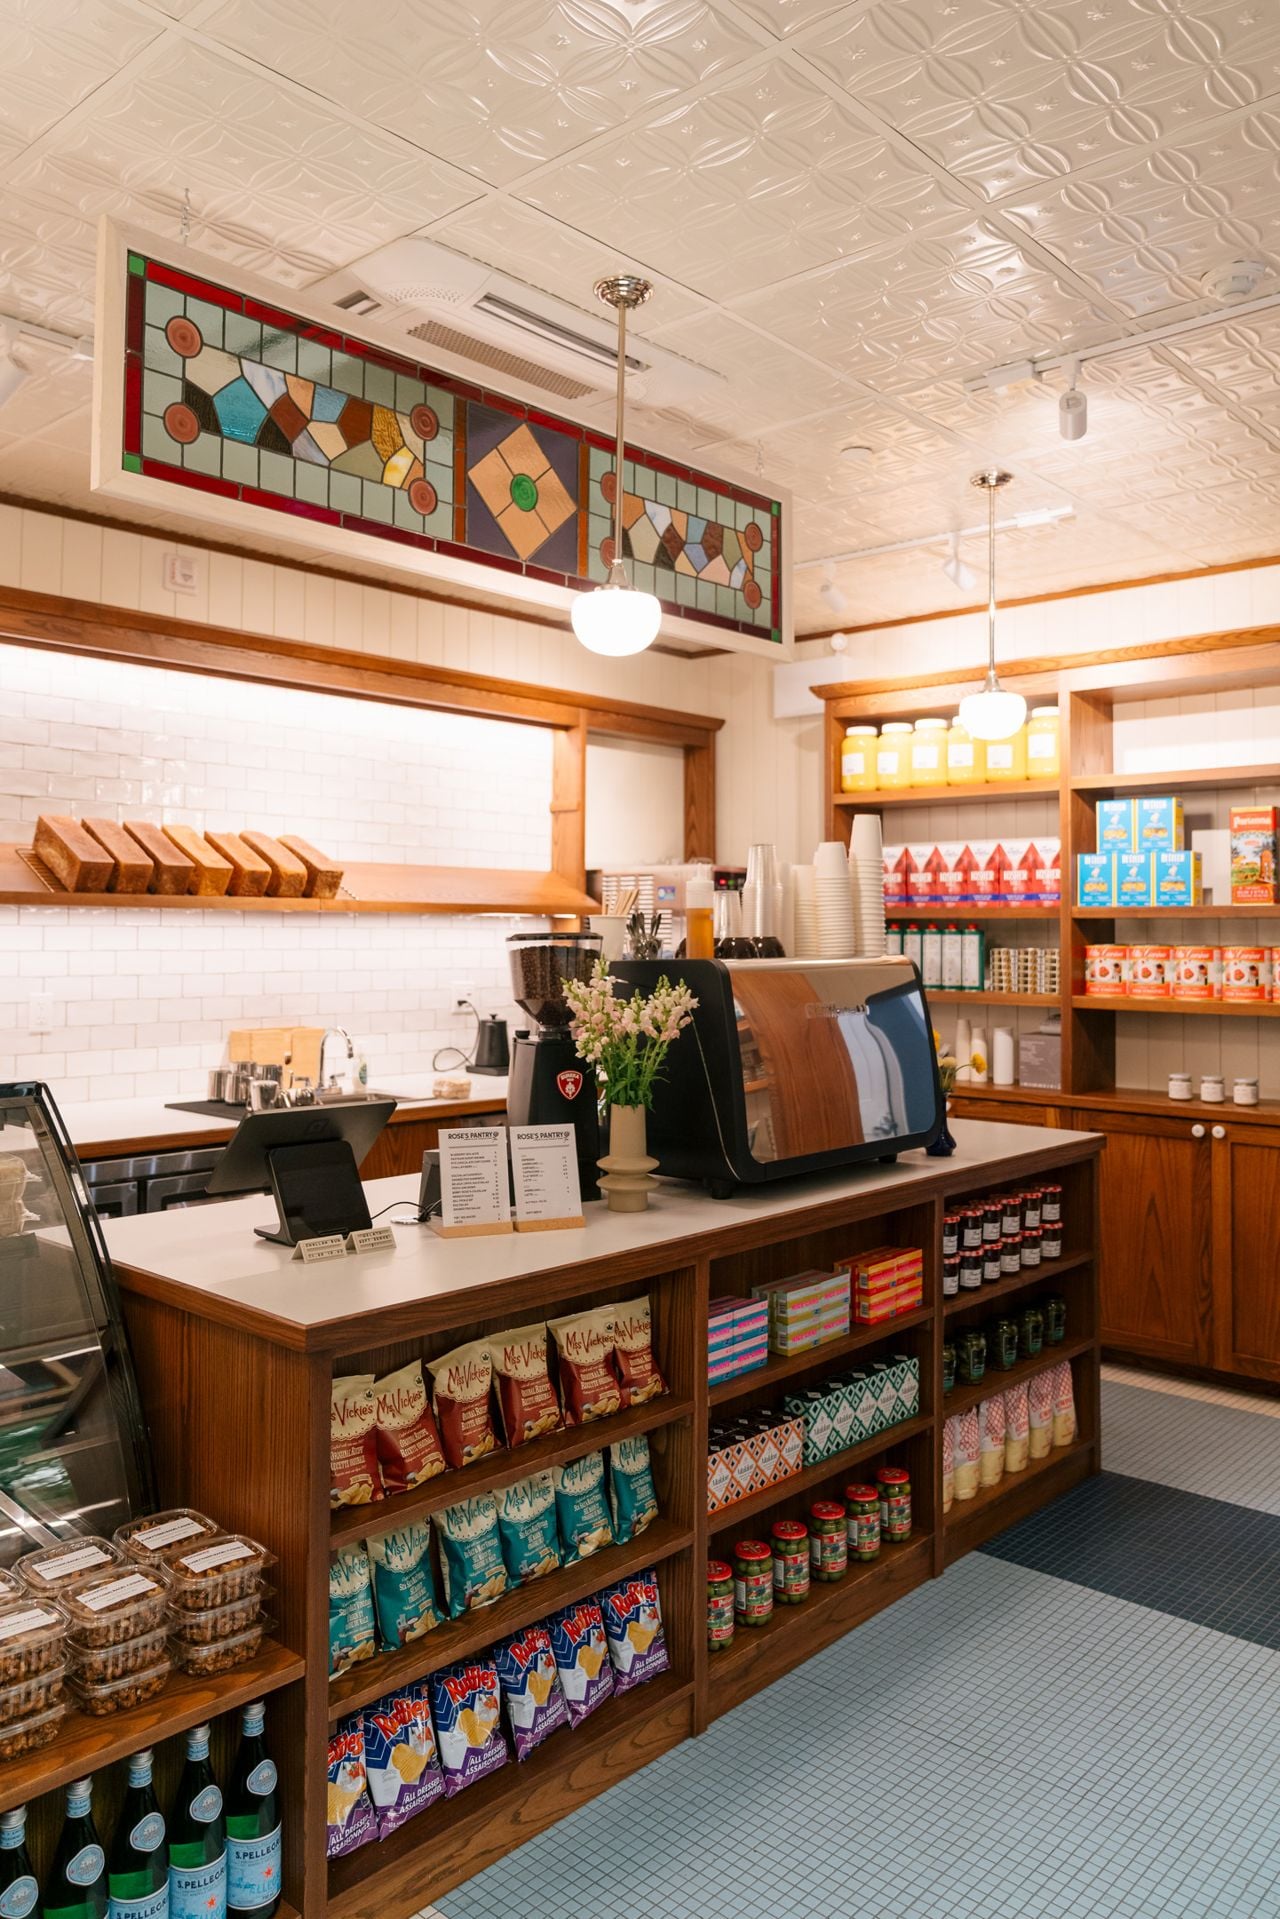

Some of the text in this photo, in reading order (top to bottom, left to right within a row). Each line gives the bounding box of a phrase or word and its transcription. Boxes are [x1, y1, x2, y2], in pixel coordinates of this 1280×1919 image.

[470, 1131, 492, 1139] PANTRY
[540, 1131, 564, 1139] PANTRY
[566, 1329, 614, 1356] Miss Vickie's
[504, 1345, 520, 1372] Miss
[447, 1361, 490, 1394] Miss Vickie's
[334, 1398, 374, 1426] Vickie's
[392, 1388, 423, 1415] Vickie's
[503, 1487, 525, 1516] Miss
[522, 1481, 551, 1508] Vickie's
[445, 1498, 495, 1535] Miss Vickie's
[384, 1534, 405, 1564] Miss
[610, 1580, 657, 1620] Ruffles
[561, 1604, 602, 1645] Ruffles
[508, 1627, 551, 1670] Ruffles
[442, 1665, 497, 1706] Ruffles
[370, 1697, 431, 1742] Ruffles
[469, 1755, 482, 1766] ALL
[404, 1791, 418, 1803] ALL
[330, 1832, 345, 1846] ALL
